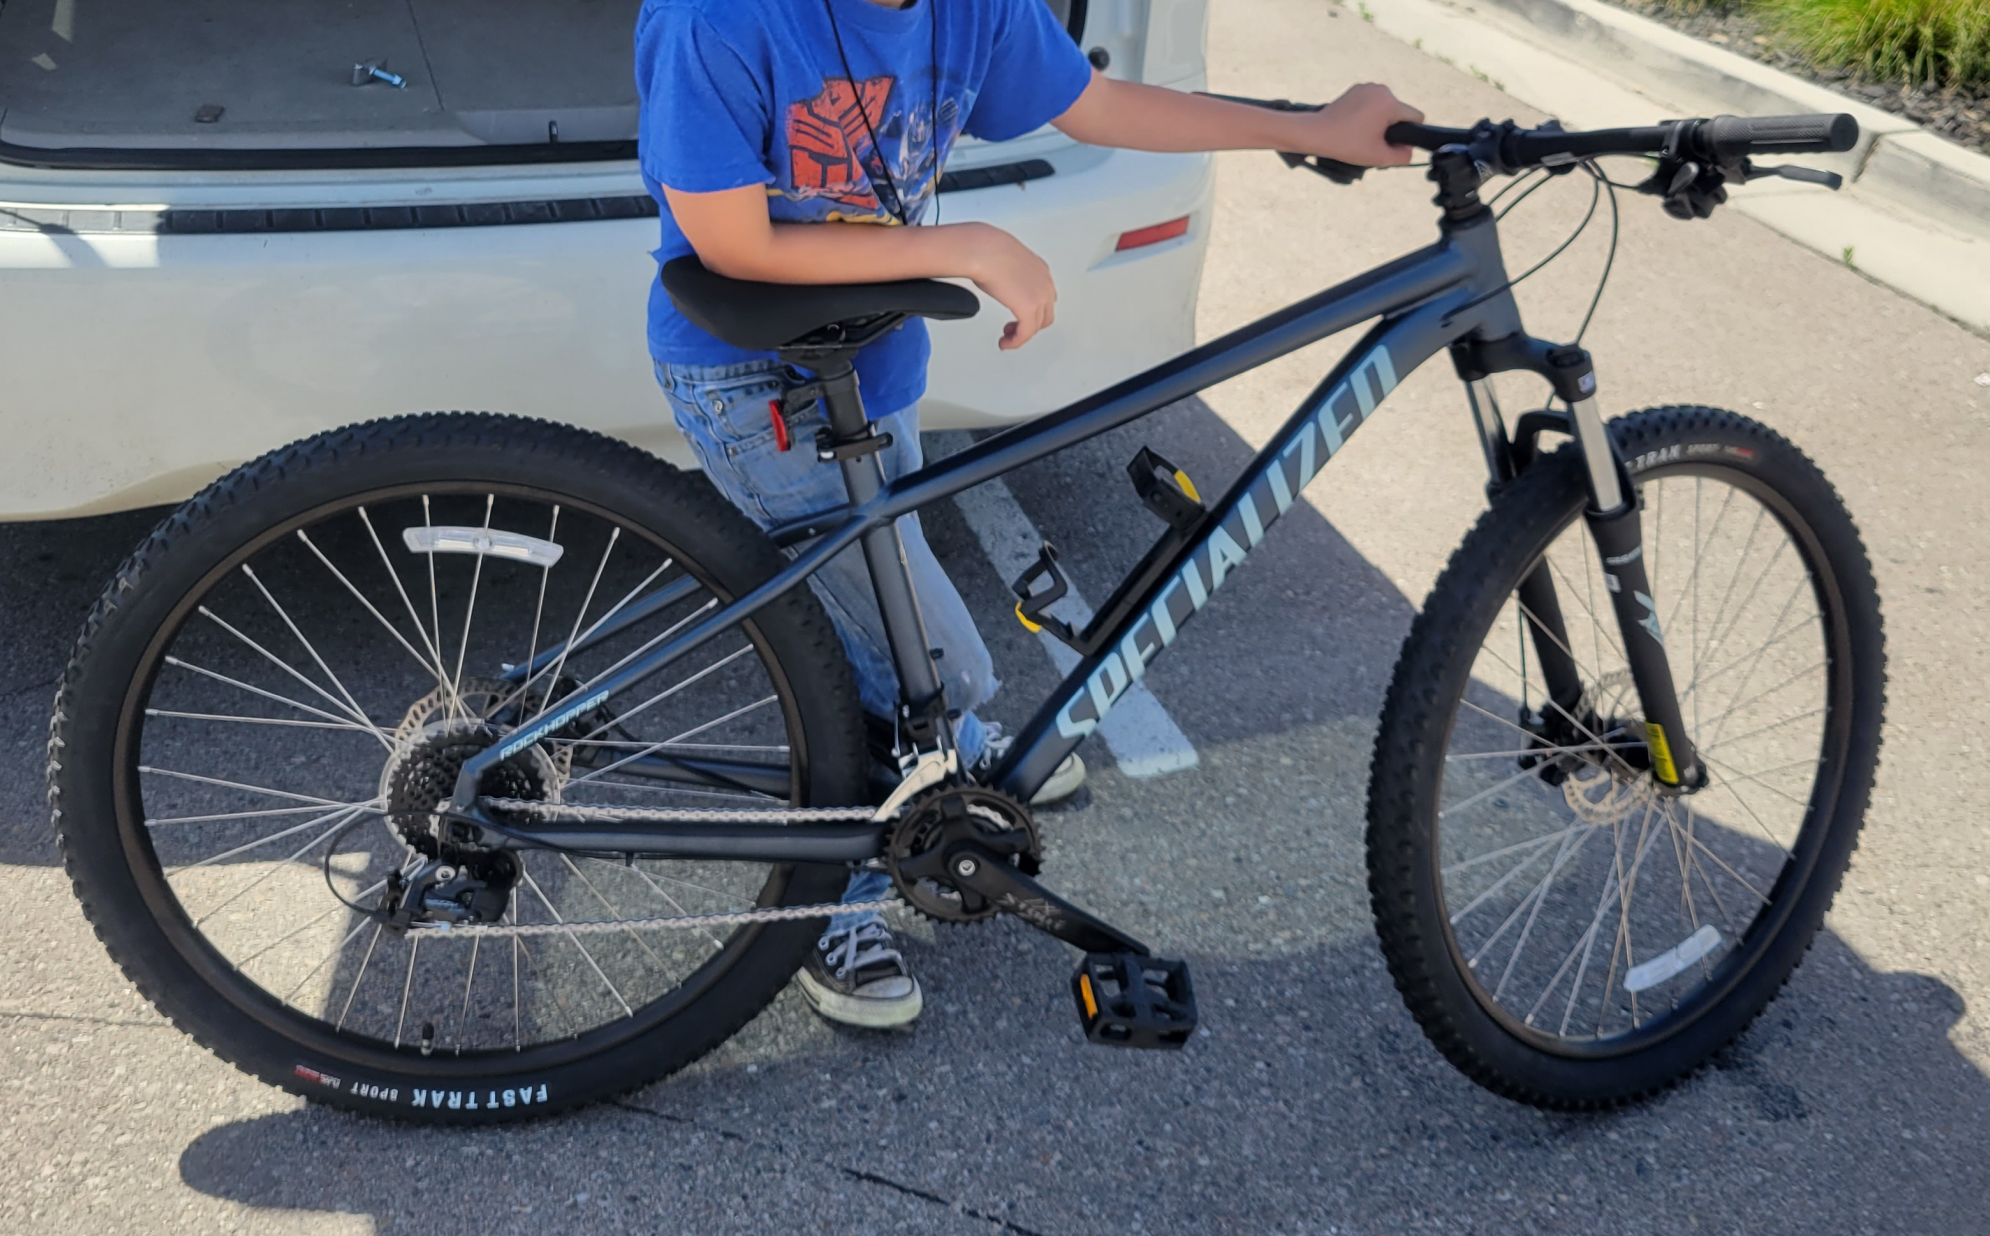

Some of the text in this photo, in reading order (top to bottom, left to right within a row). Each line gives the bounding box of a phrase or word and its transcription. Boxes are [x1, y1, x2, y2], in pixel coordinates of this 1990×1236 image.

[1635, 443, 1682, 471] TRAK
[500, 689, 610, 761] ROCKHOPPER
[350, 1081, 549, 1110] FAST TRAK SPORT
